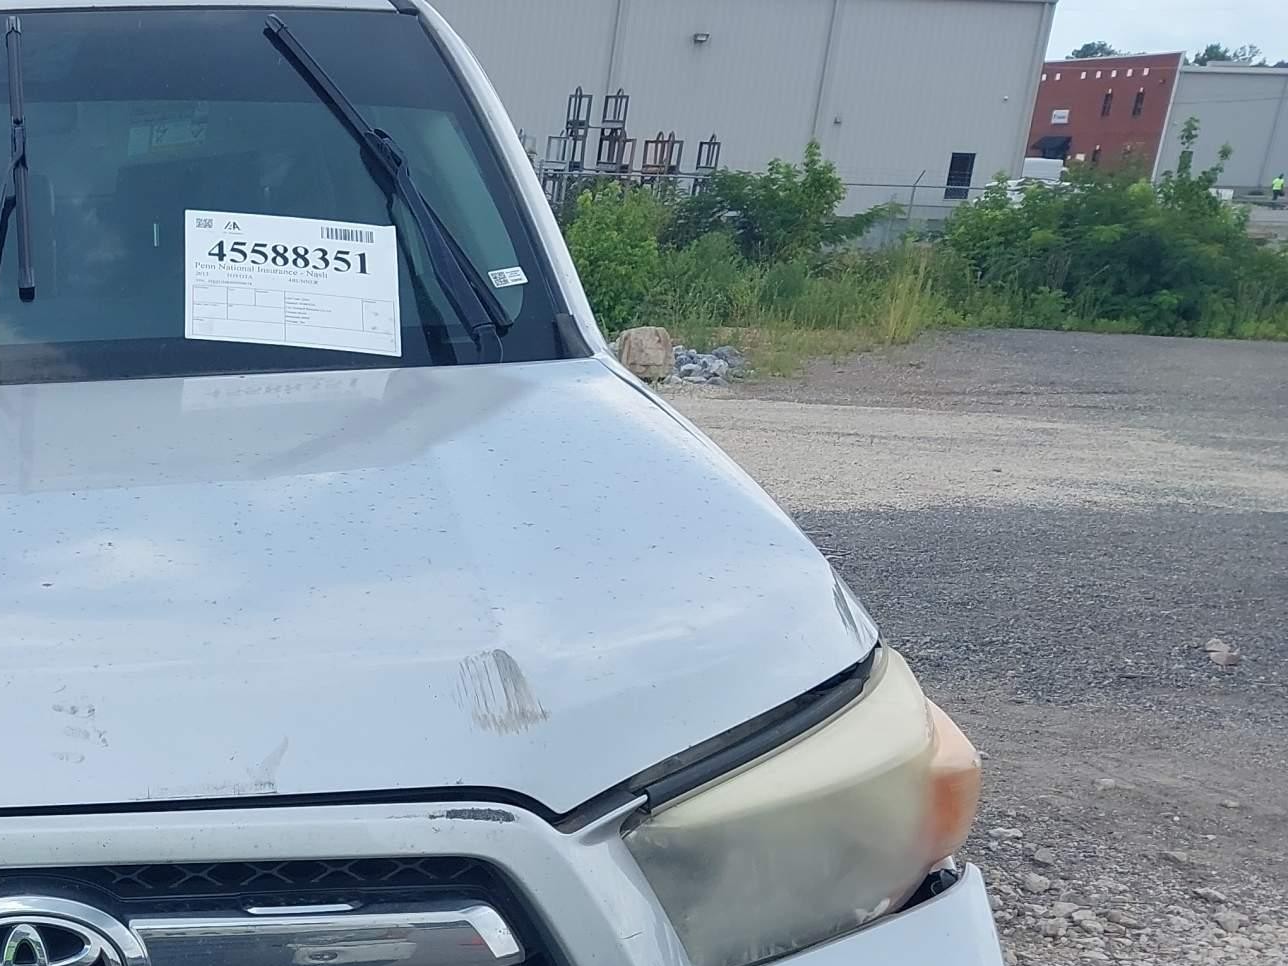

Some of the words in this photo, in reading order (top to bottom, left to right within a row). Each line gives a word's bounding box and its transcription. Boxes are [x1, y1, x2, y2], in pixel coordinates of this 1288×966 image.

[195, 262, 216, 270] Penn
[218, 263, 255, 272] National
[257, 266, 298, 276] Insurance
[208, 240, 372, 275] 45588351
